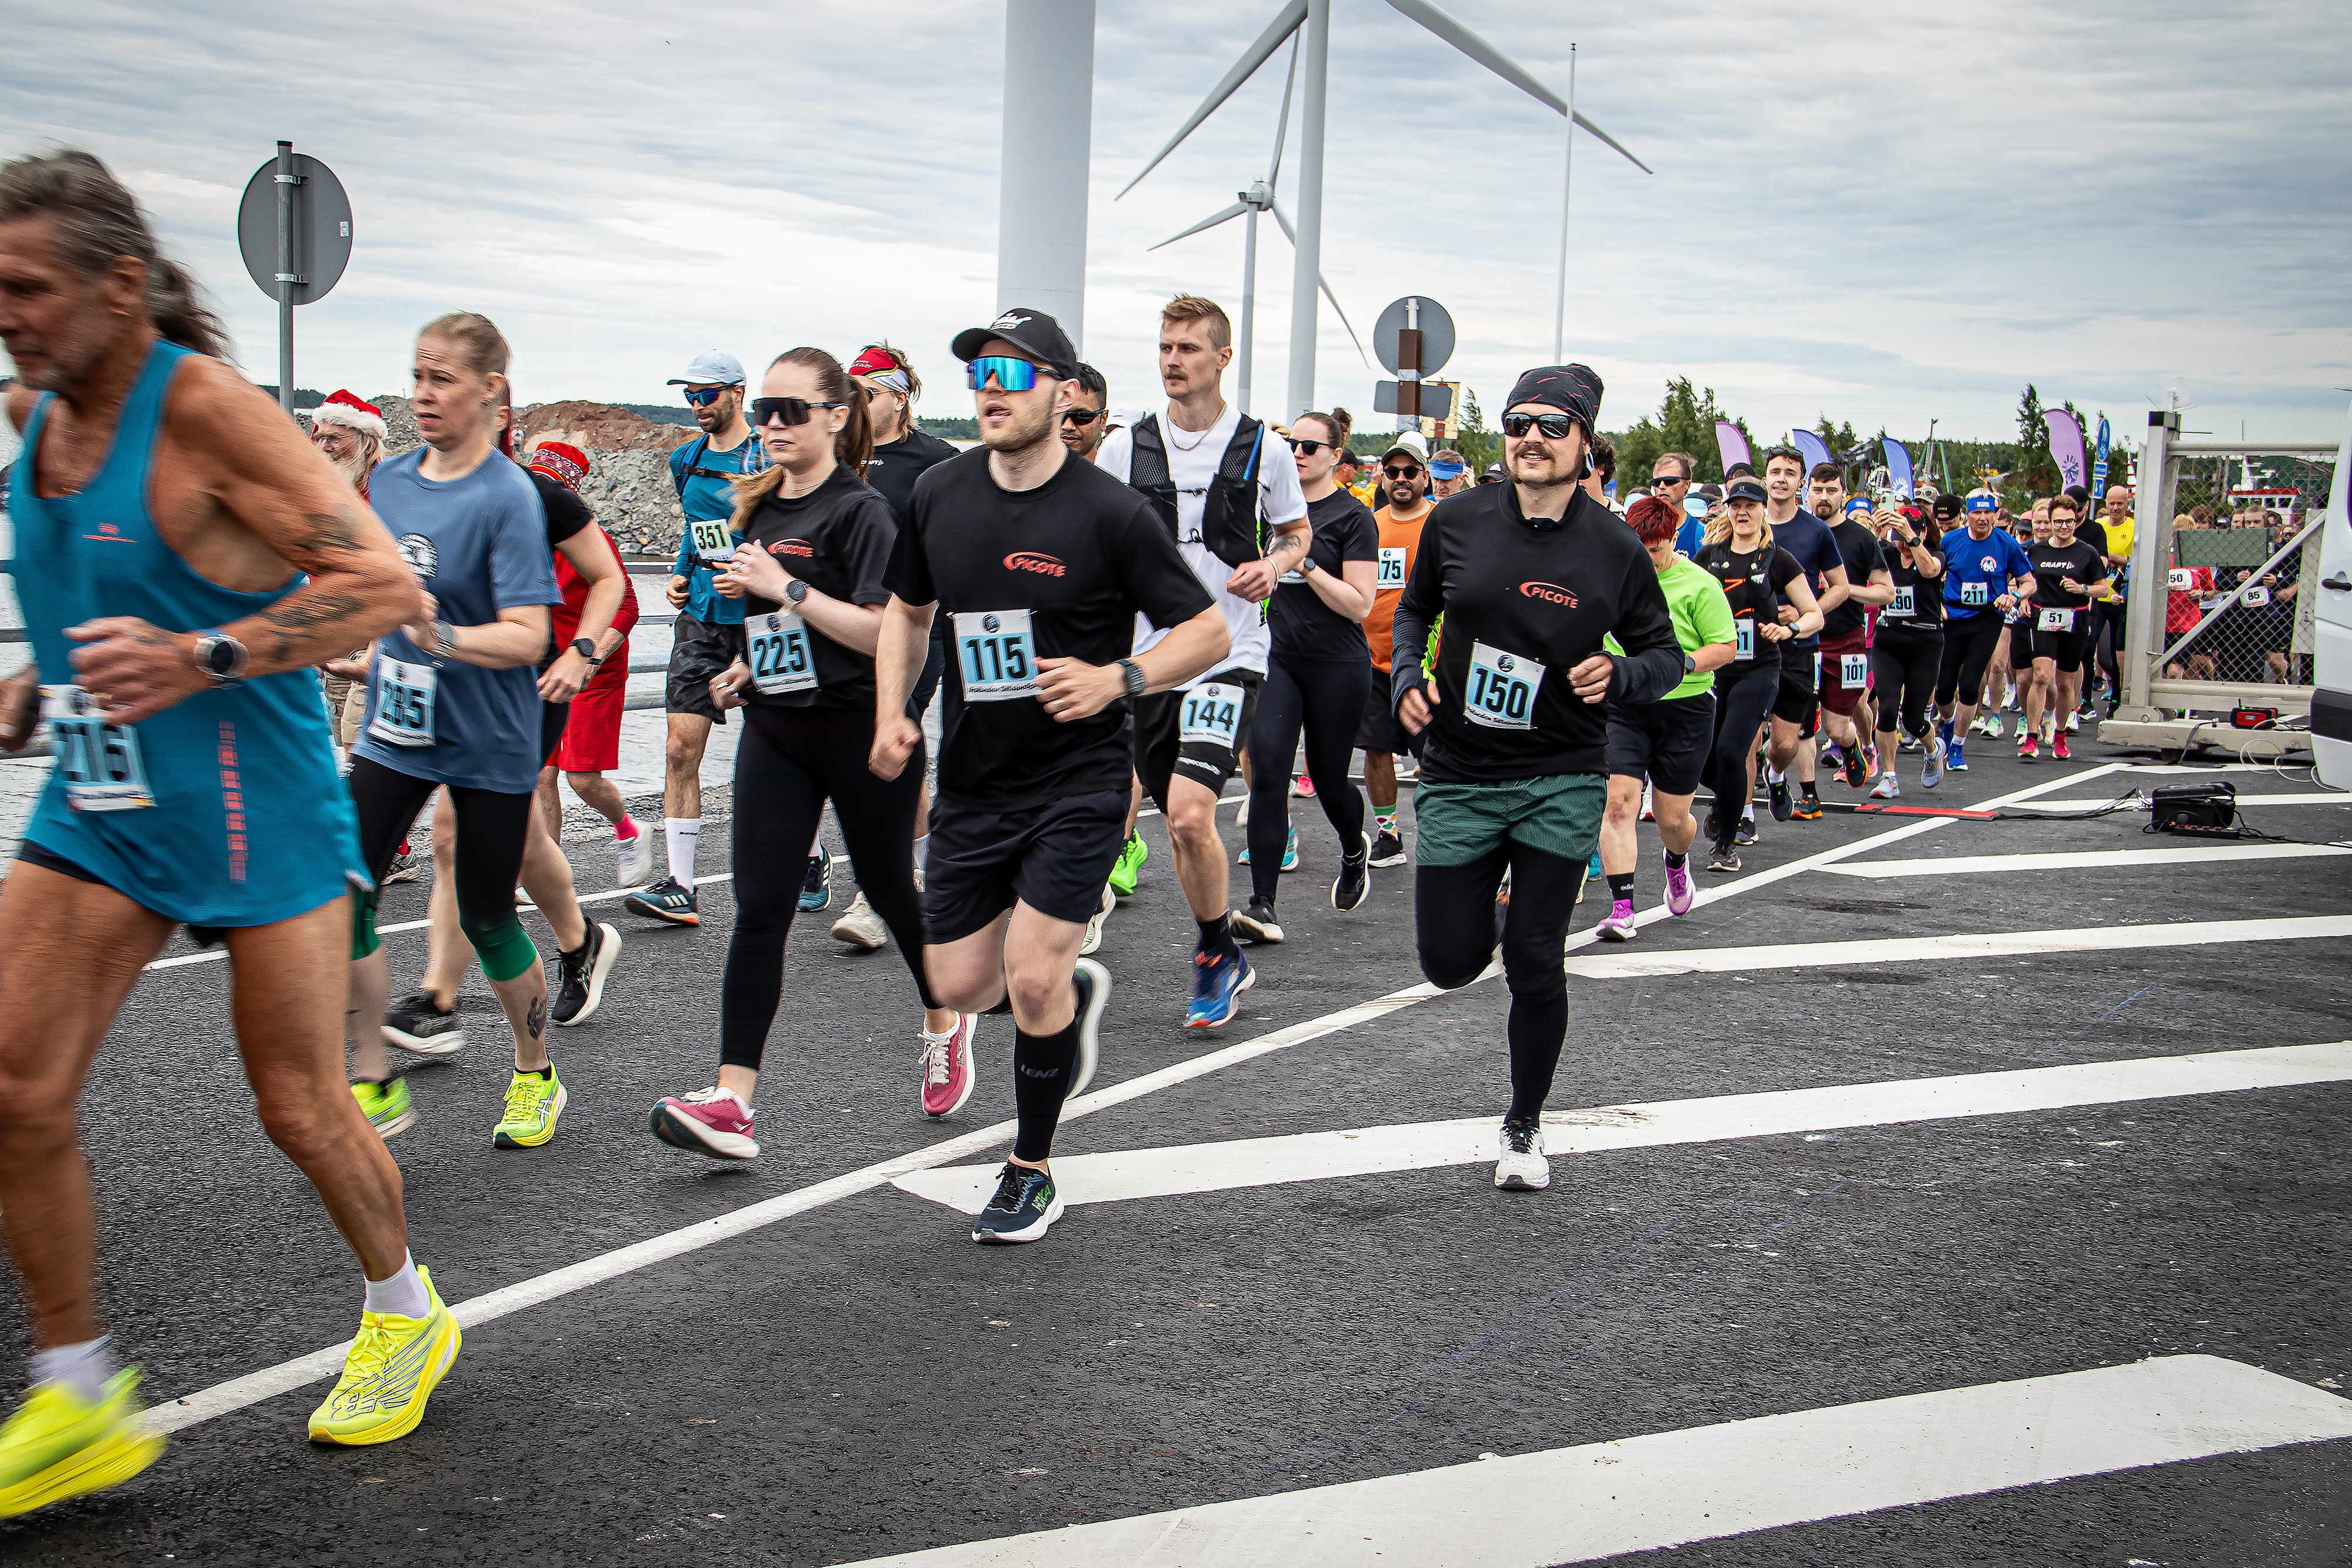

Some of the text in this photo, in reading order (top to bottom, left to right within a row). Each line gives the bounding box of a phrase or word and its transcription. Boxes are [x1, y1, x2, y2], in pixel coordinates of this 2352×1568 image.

[695, 524, 727, 550] 351
[1378, 560, 1401, 580] 75
[2170, 574, 2183, 583] 50
[1531, 586, 1579, 609] PICOTE
[1964, 590, 1984, 604] 211
[2247, 590, 2260, 601] 85
[2049, 612, 2062, 623] 51
[753, 633, 807, 678] 225
[965, 636, 1028, 681] 115
[1845, 664, 1864, 681] 101
[1474, 667, 1529, 719] 150
[1188, 699, 1235, 732] 144
